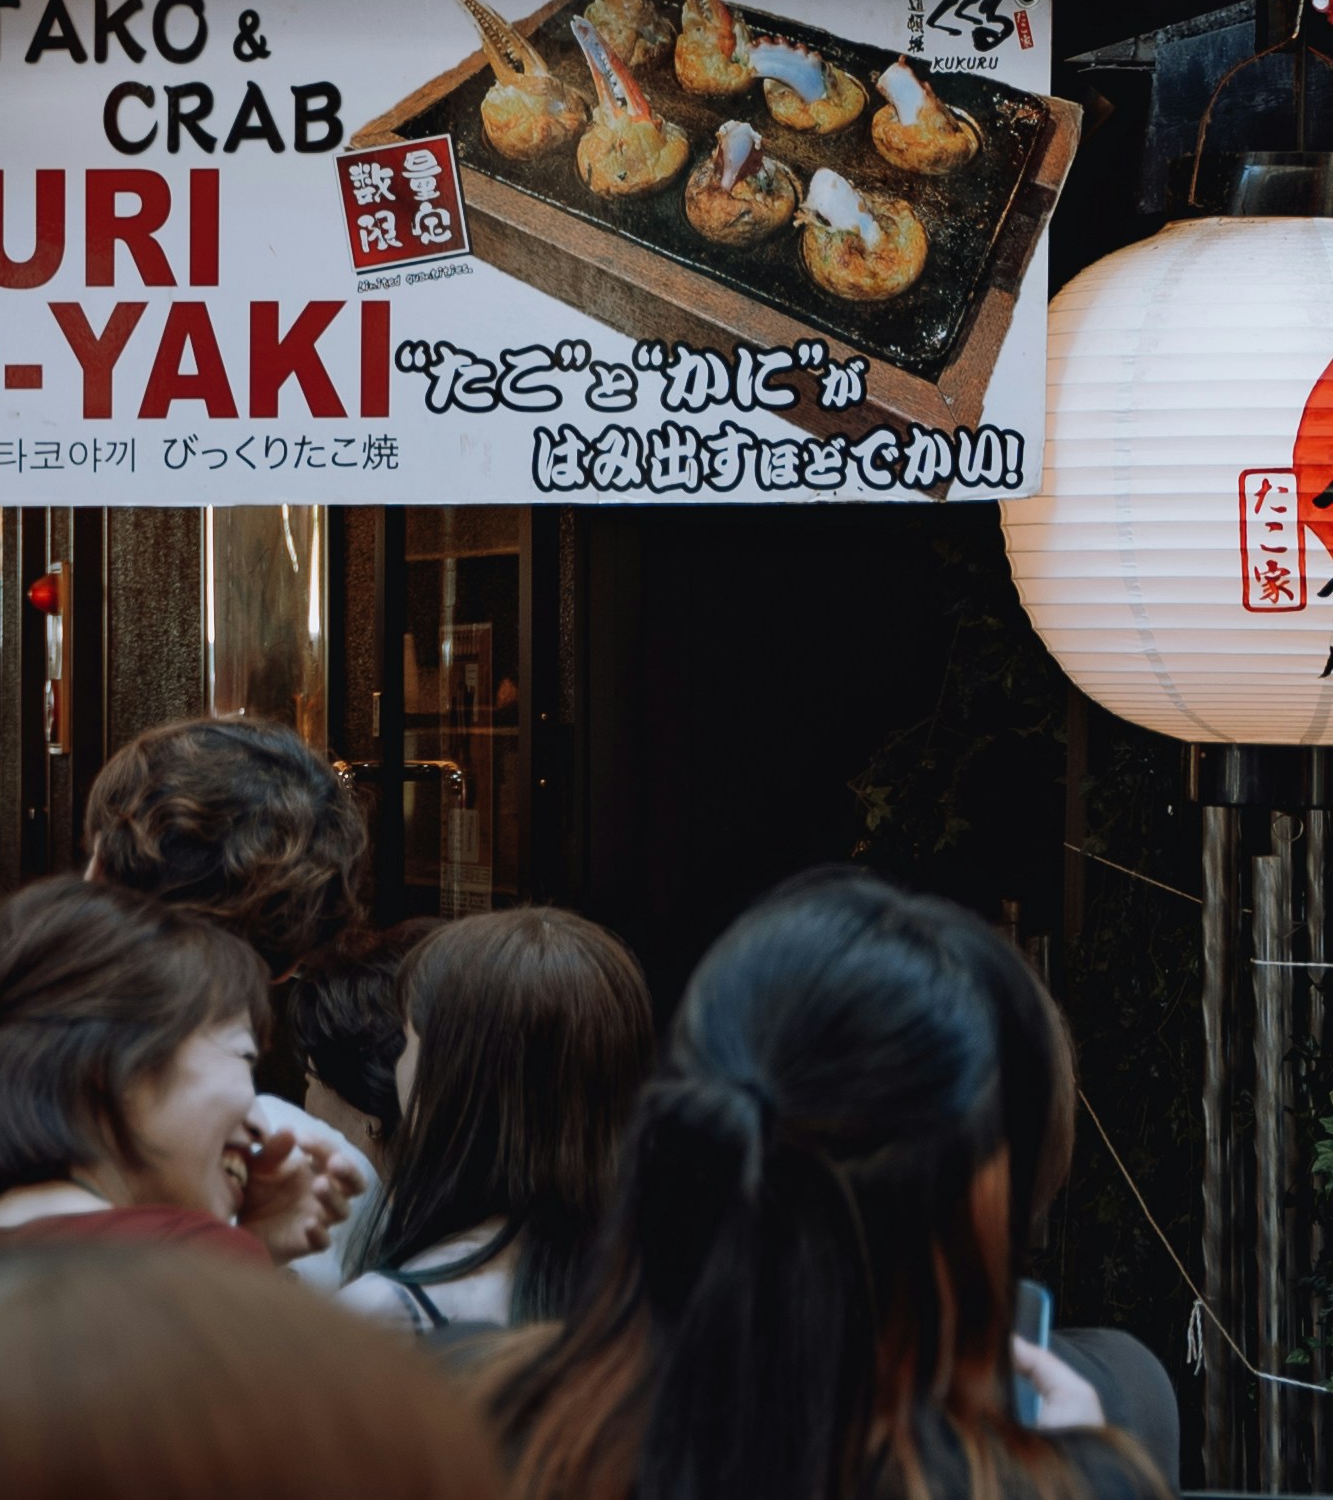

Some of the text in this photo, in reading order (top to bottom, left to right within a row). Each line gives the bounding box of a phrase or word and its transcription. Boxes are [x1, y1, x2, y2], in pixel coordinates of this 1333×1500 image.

[232, 7, 272, 62] &
[933, 56, 999, 70] KUKURU
[102, 80, 345, 156] CRAB
[162, 433, 400, 471] びっくりたこ焼
[1253, 477, 1295, 604] たこ家
